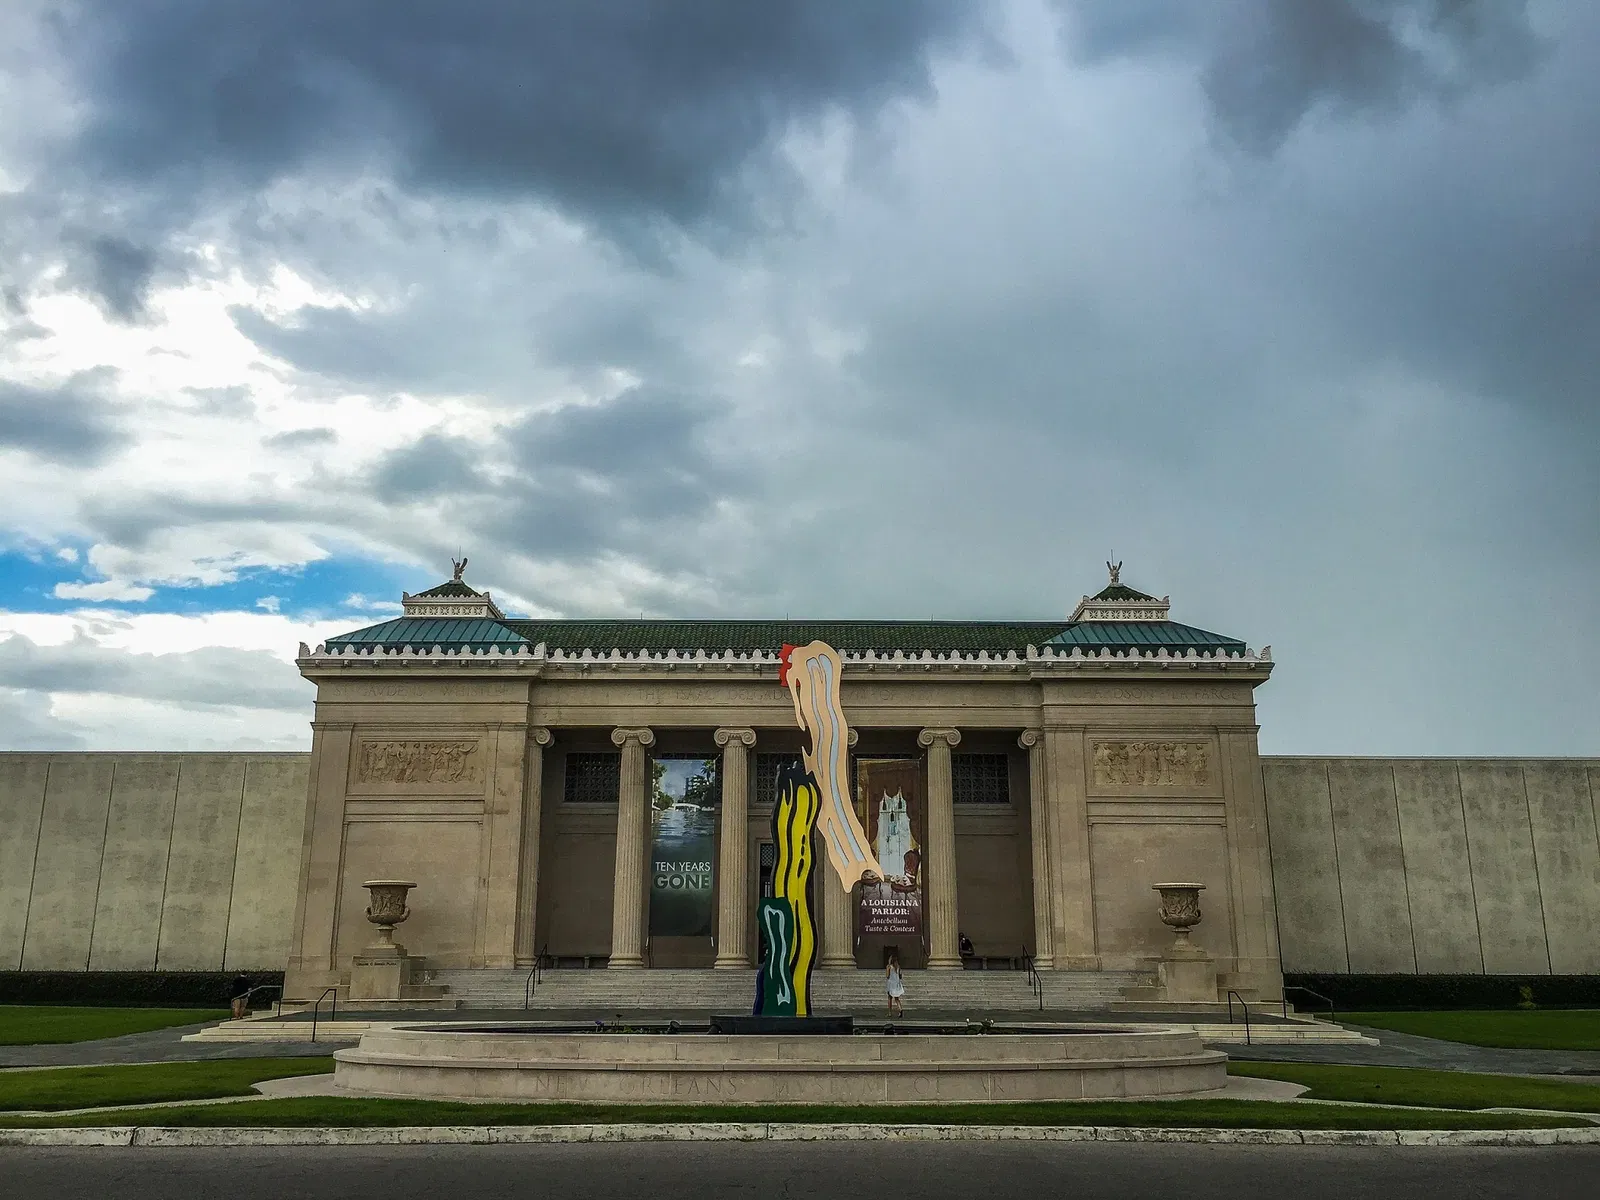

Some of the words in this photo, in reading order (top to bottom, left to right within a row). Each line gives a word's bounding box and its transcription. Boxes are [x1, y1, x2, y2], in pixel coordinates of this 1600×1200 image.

[655, 861, 676, 872] TEN
[678, 861, 711, 872] YEARS
[653, 873, 710, 889] GONE
[871, 907, 910, 915] PARLOR:
[535, 1075, 590, 1093] NEW
[619, 1076, 738, 1096] ORLEANS
